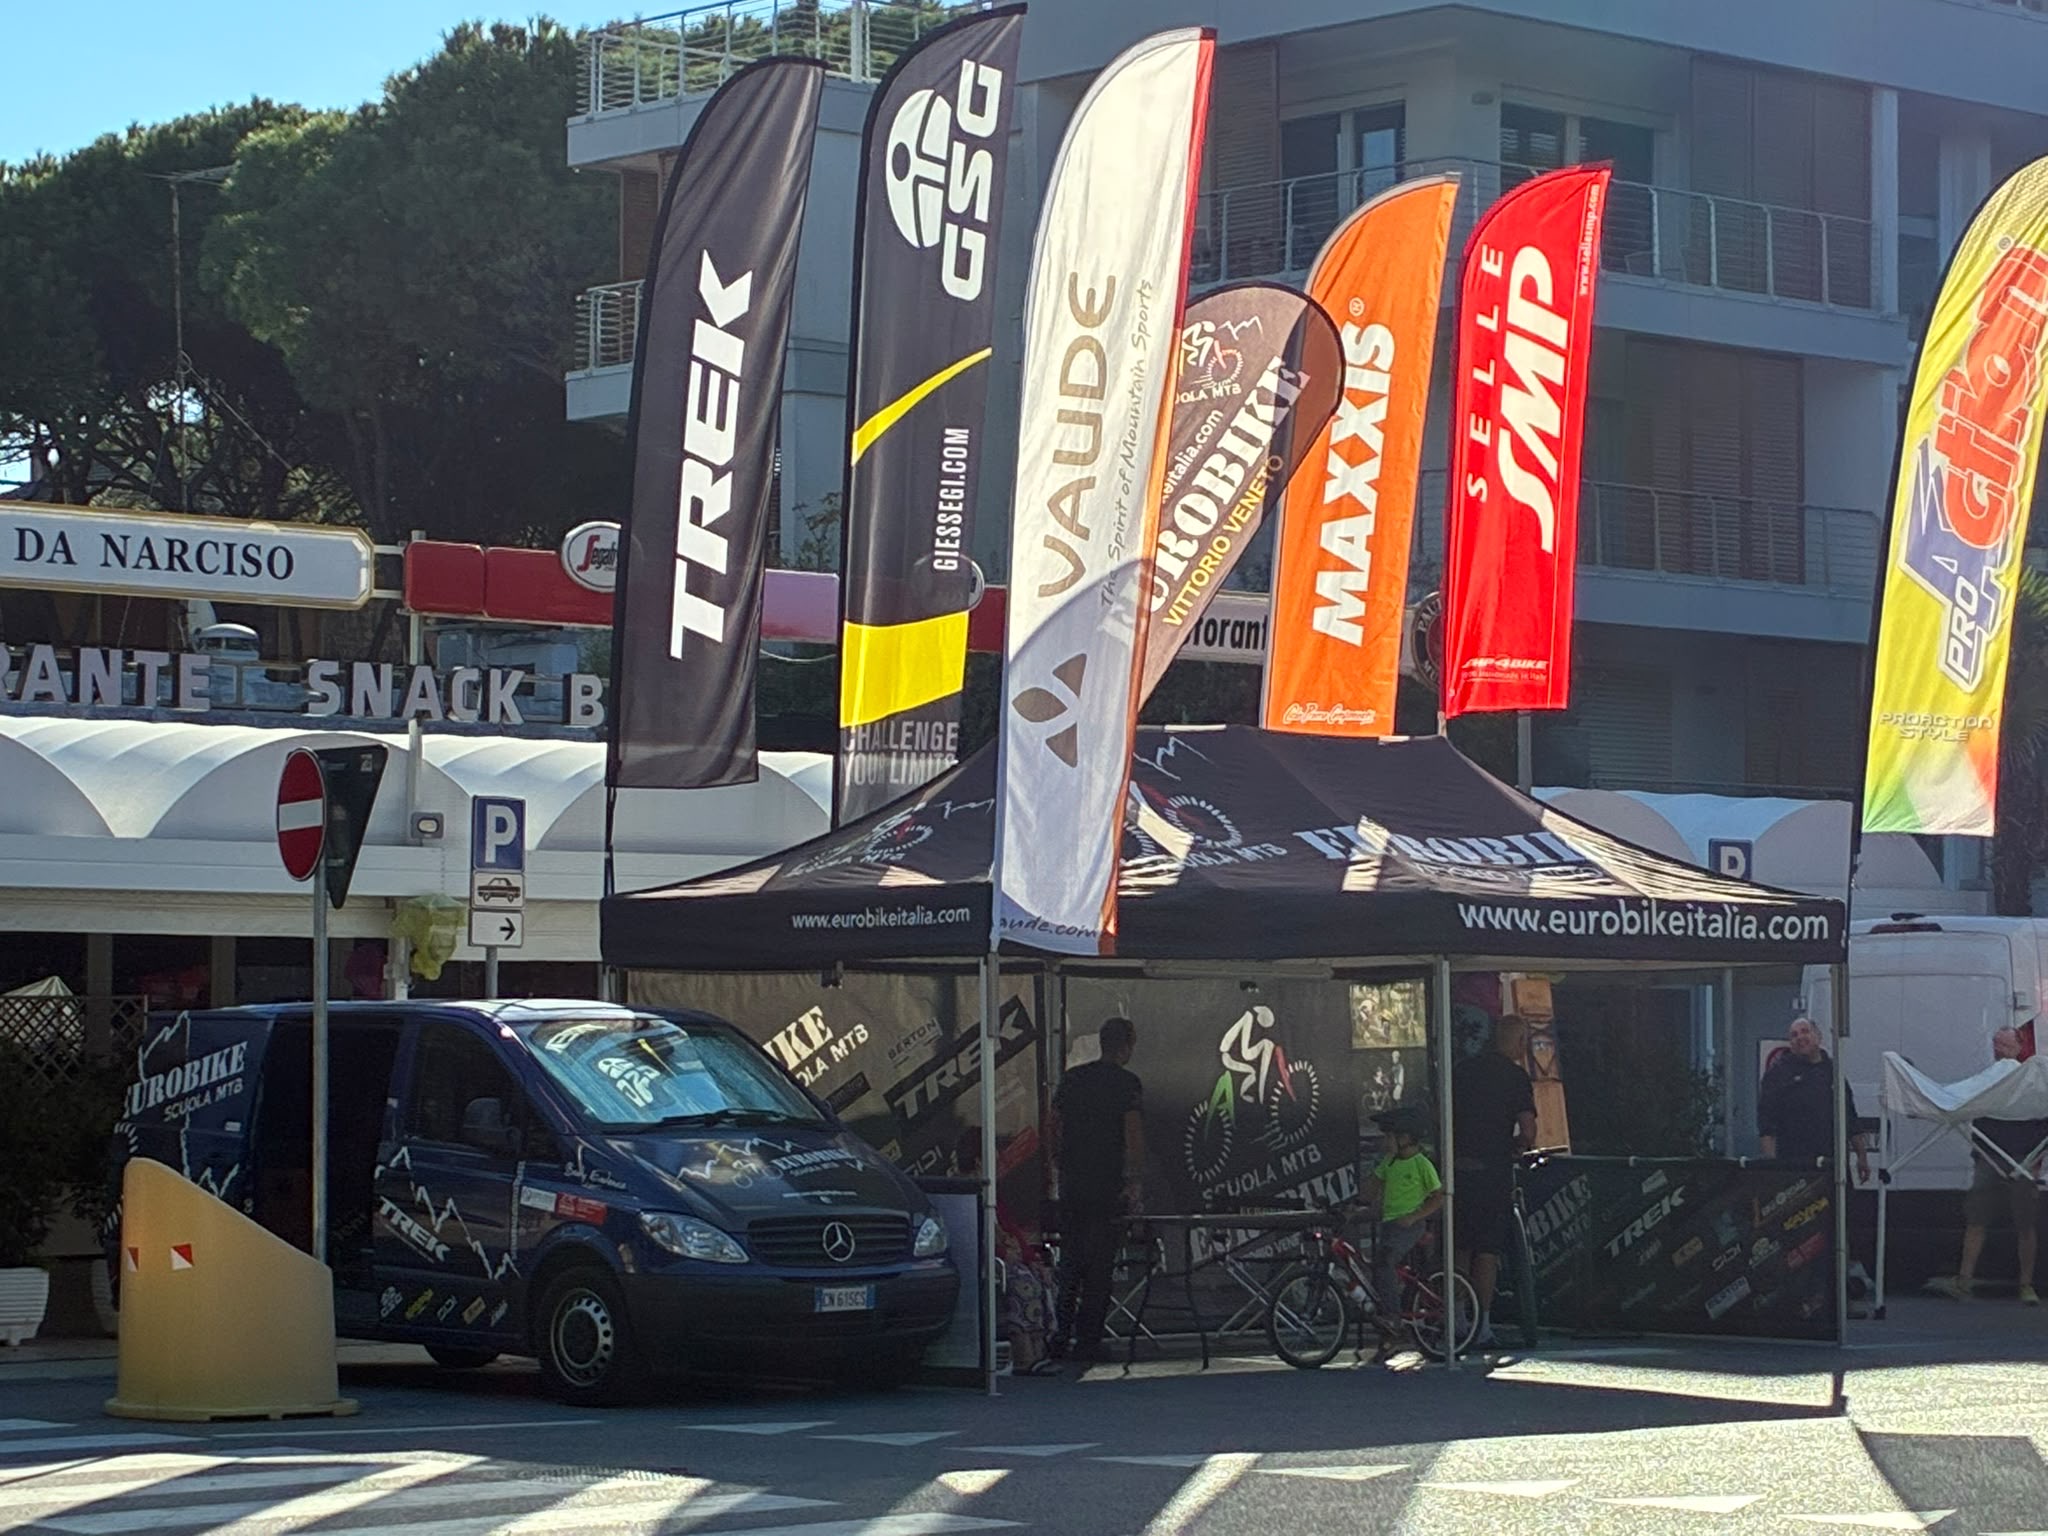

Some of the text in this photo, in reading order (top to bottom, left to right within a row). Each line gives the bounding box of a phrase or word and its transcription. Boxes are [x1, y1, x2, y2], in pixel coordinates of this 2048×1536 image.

[941, 59, 1003, 301] GSG
[1212, 383, 1242, 399] MTB
[1466, 244, 1504, 503] SELLE
[1497, 245, 1569, 555] SMP
[669, 249, 753, 660] TREK
[1037, 271, 1116, 598] VAUDE
[1101, 279, 1153, 606] The Spirit of Mountain Sports
[933, 428, 970, 572] GIESSEGI.COM
[1150, 355, 1311, 613] UROBIKE
[1312, 320, 1395, 648] MAXXIS
[14, 526, 295, 581] DA NARCISO
[1161, 455, 1284, 627] VITTORIO VENETO
[1946, 577, 1980, 677] PRO
[0, 642, 211, 712] ANTE
[307, 658, 525, 726] SNACK
[1900, 727, 1969, 742] STYLE
[483, 802, 519, 865] P
[792, 906, 970, 929] www.eurobikeitalia.com
[1000, 915, 1097, 938] aude.com
[1457, 900, 1829, 941] www.eurobikeitalia.com
[830, 1024, 869, 1062] MTB
[888, 1018, 936, 1061] BERTON
[894, 1007, 1024, 1119] TREK
[163, 1077, 244, 1122] SCUOLA MTB
[1281, 1143, 1322, 1177] MTB
[377, 1196, 451, 1263] TREK
[1603, 1185, 1686, 1258] TREK
